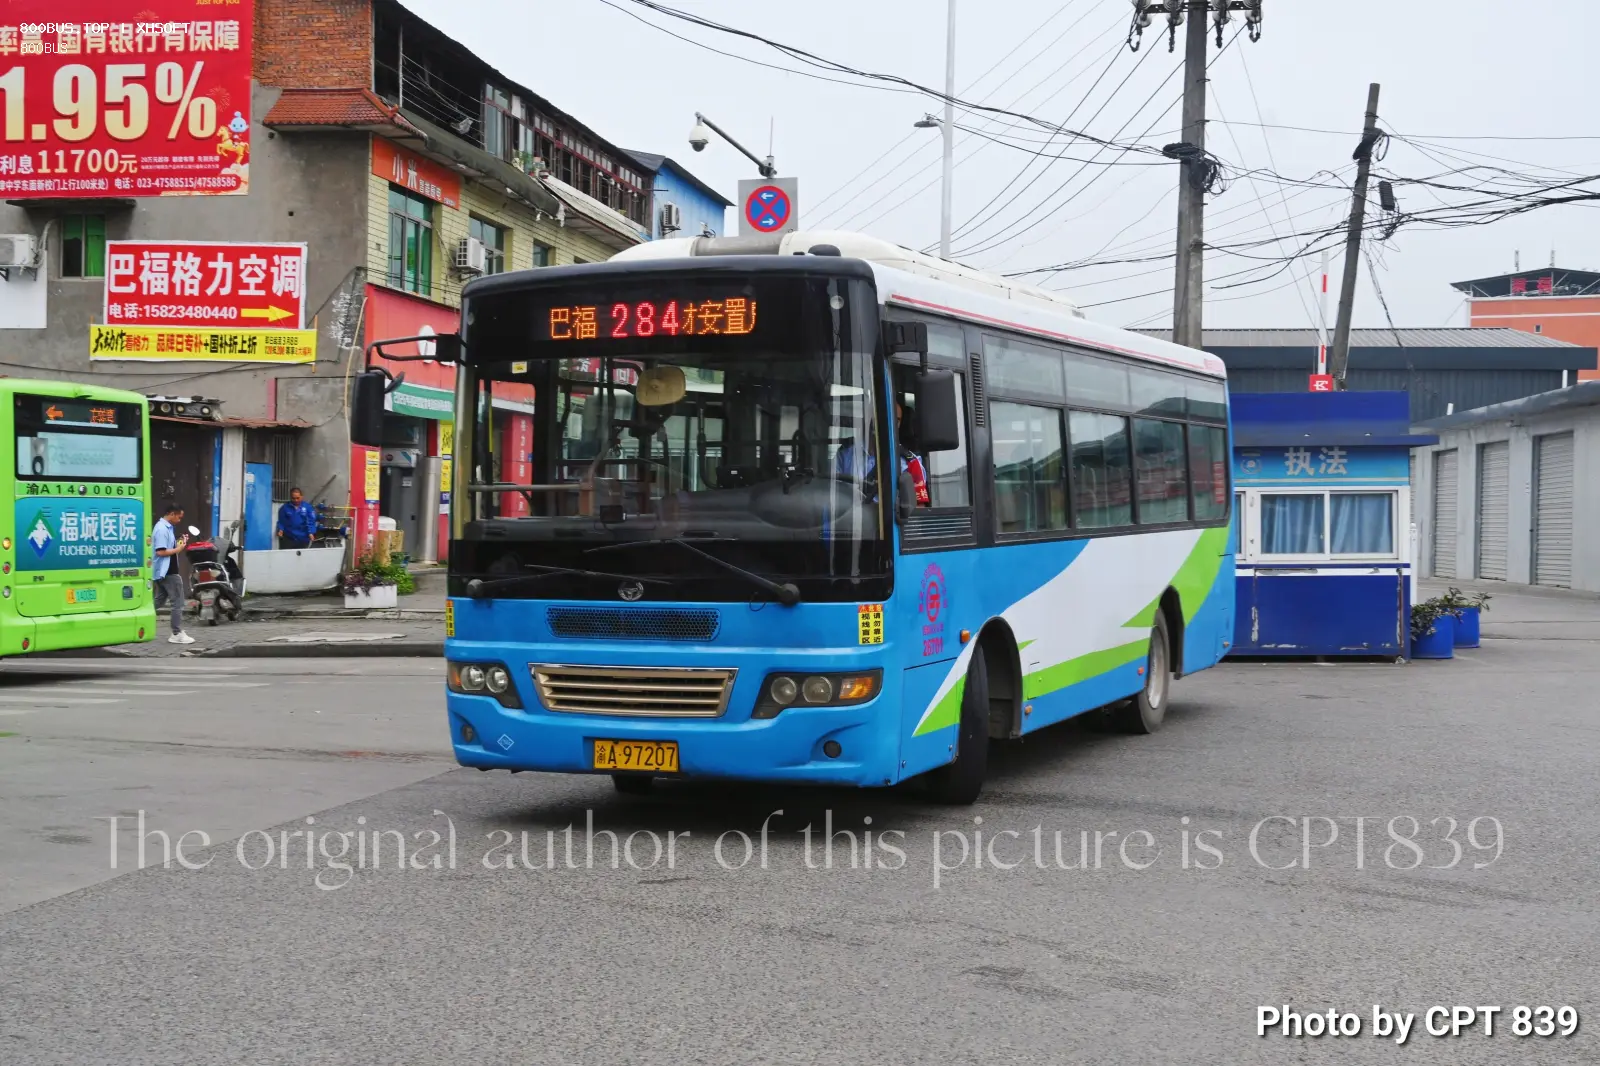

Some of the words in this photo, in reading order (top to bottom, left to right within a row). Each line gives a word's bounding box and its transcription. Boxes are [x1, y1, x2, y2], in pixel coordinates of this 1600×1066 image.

[0, 61, 216, 142] 1.95%
[392, 153, 418, 189] 小米
[109, 251, 300, 298] 巴福格力空调
[109, 302, 237, 320] 电话:15823480440
[551, 306, 597, 339] 巴福
[612, 302, 679, 337] 284
[1284, 446, 1347, 475] 执法
[60, 512, 137, 541] 福城医院
[60, 546, 97, 555] FUCHENG
[100, 545, 136, 554] HOSPITAL
[873, 612, 881, 643] 请勿靠近
